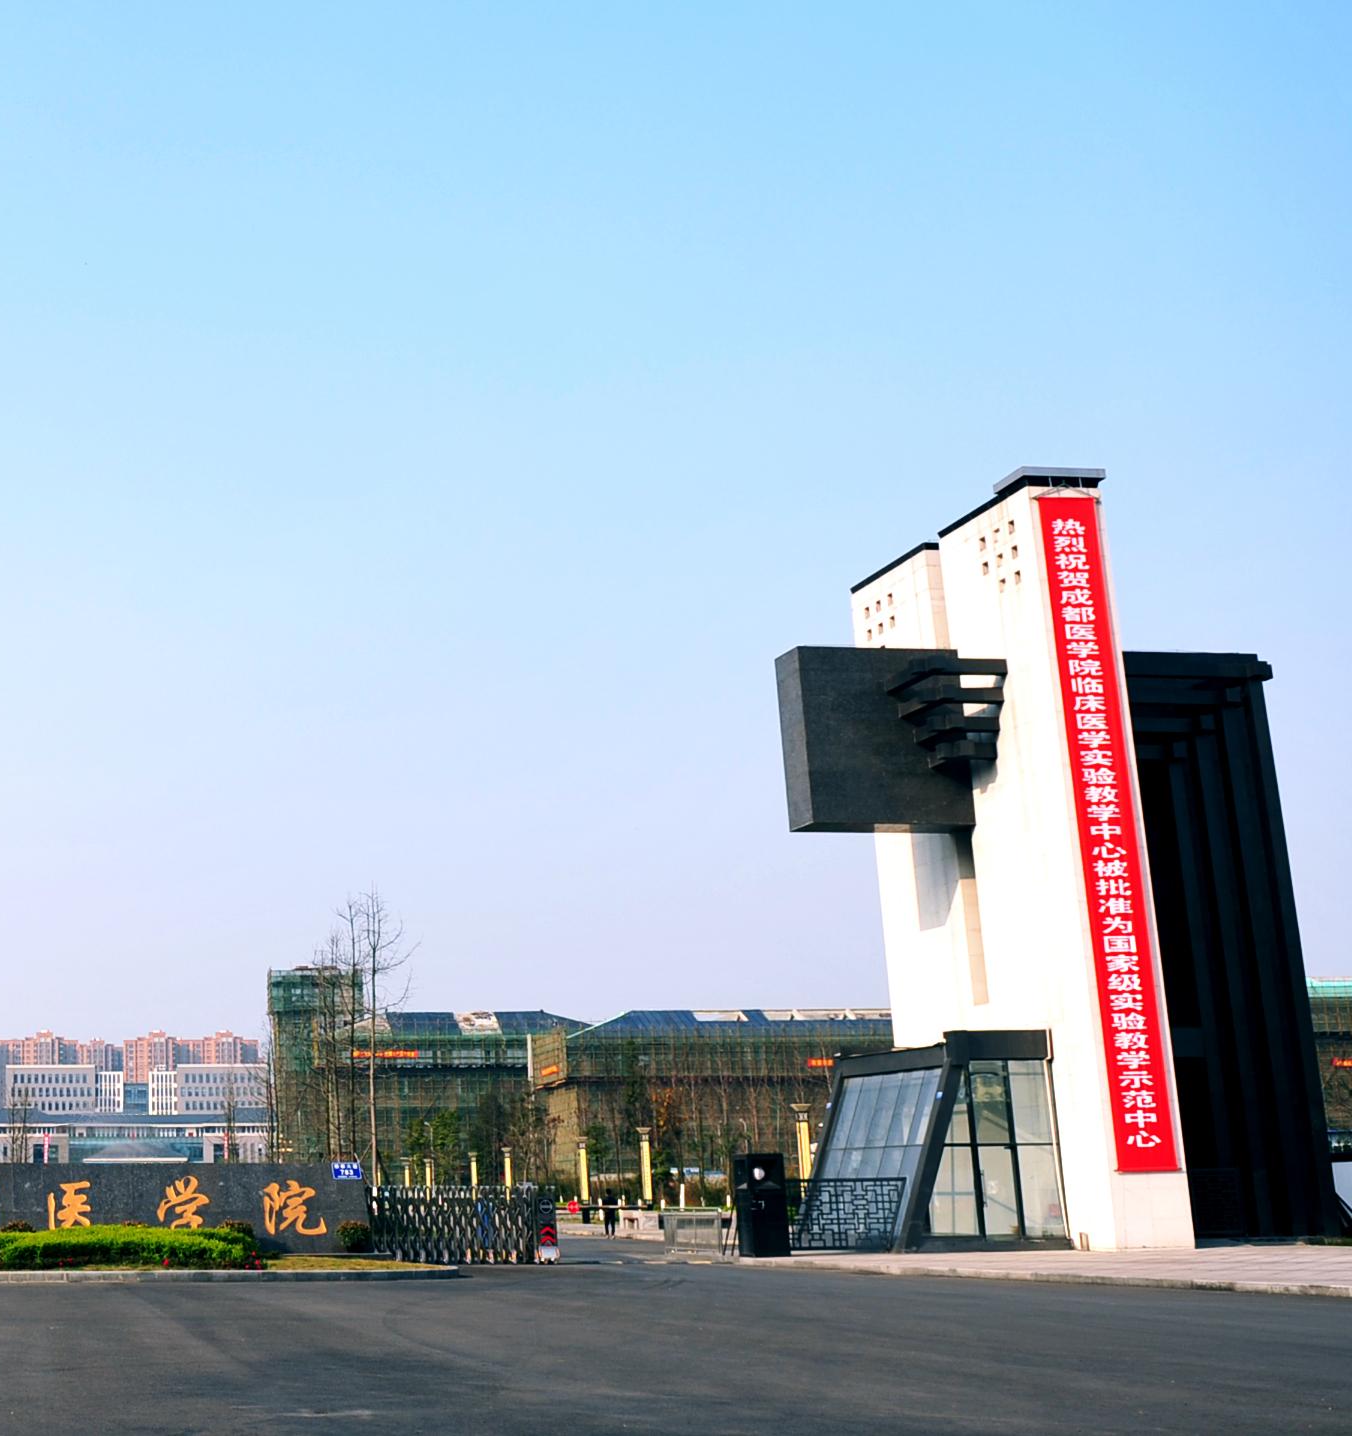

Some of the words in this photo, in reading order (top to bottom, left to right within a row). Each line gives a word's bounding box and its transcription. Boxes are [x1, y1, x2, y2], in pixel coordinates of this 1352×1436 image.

[1051, 519, 1162, 1148] 热烈祝贺成都医学院临床医学实验教学中心被批准为国家级实验教学示范中心
